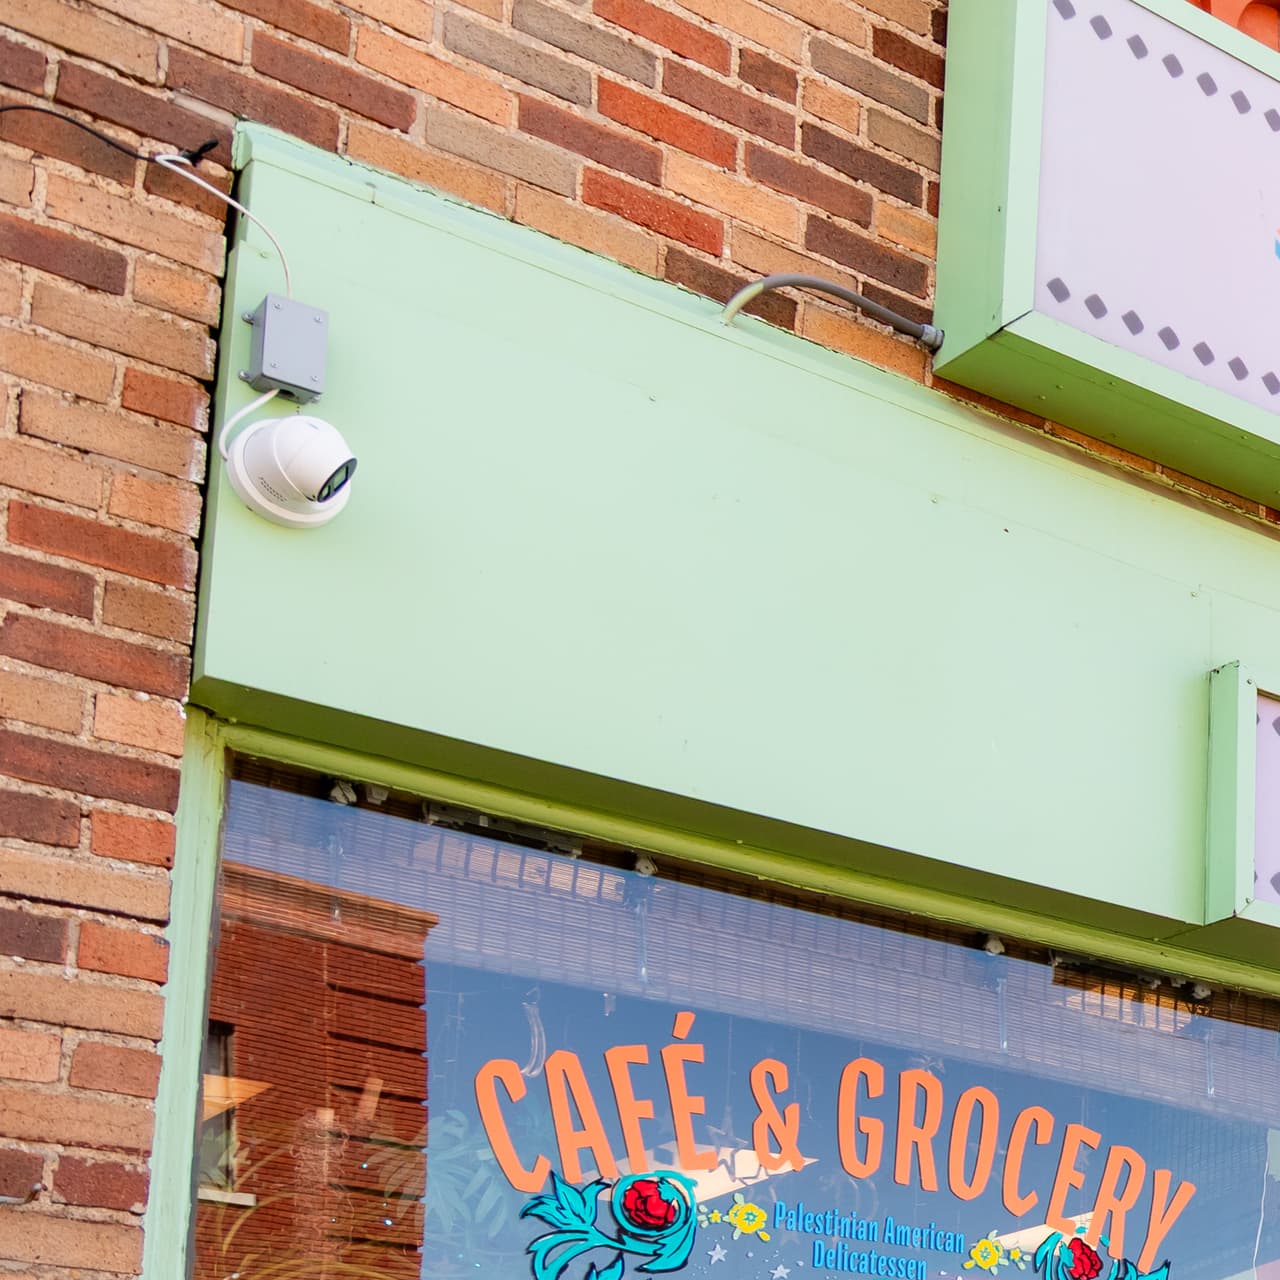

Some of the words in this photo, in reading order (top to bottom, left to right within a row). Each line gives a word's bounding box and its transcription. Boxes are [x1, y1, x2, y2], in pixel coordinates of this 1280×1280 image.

[475, 1011, 720, 1195] CAFÉ
[750, 1058, 806, 1172] &
[837, 1055, 1197, 1273] GROCERY
[773, 1200, 878, 1242] Palestinian
[883, 1215, 966, 1254] American
[813, 1239, 928, 1280] Delicatessen
